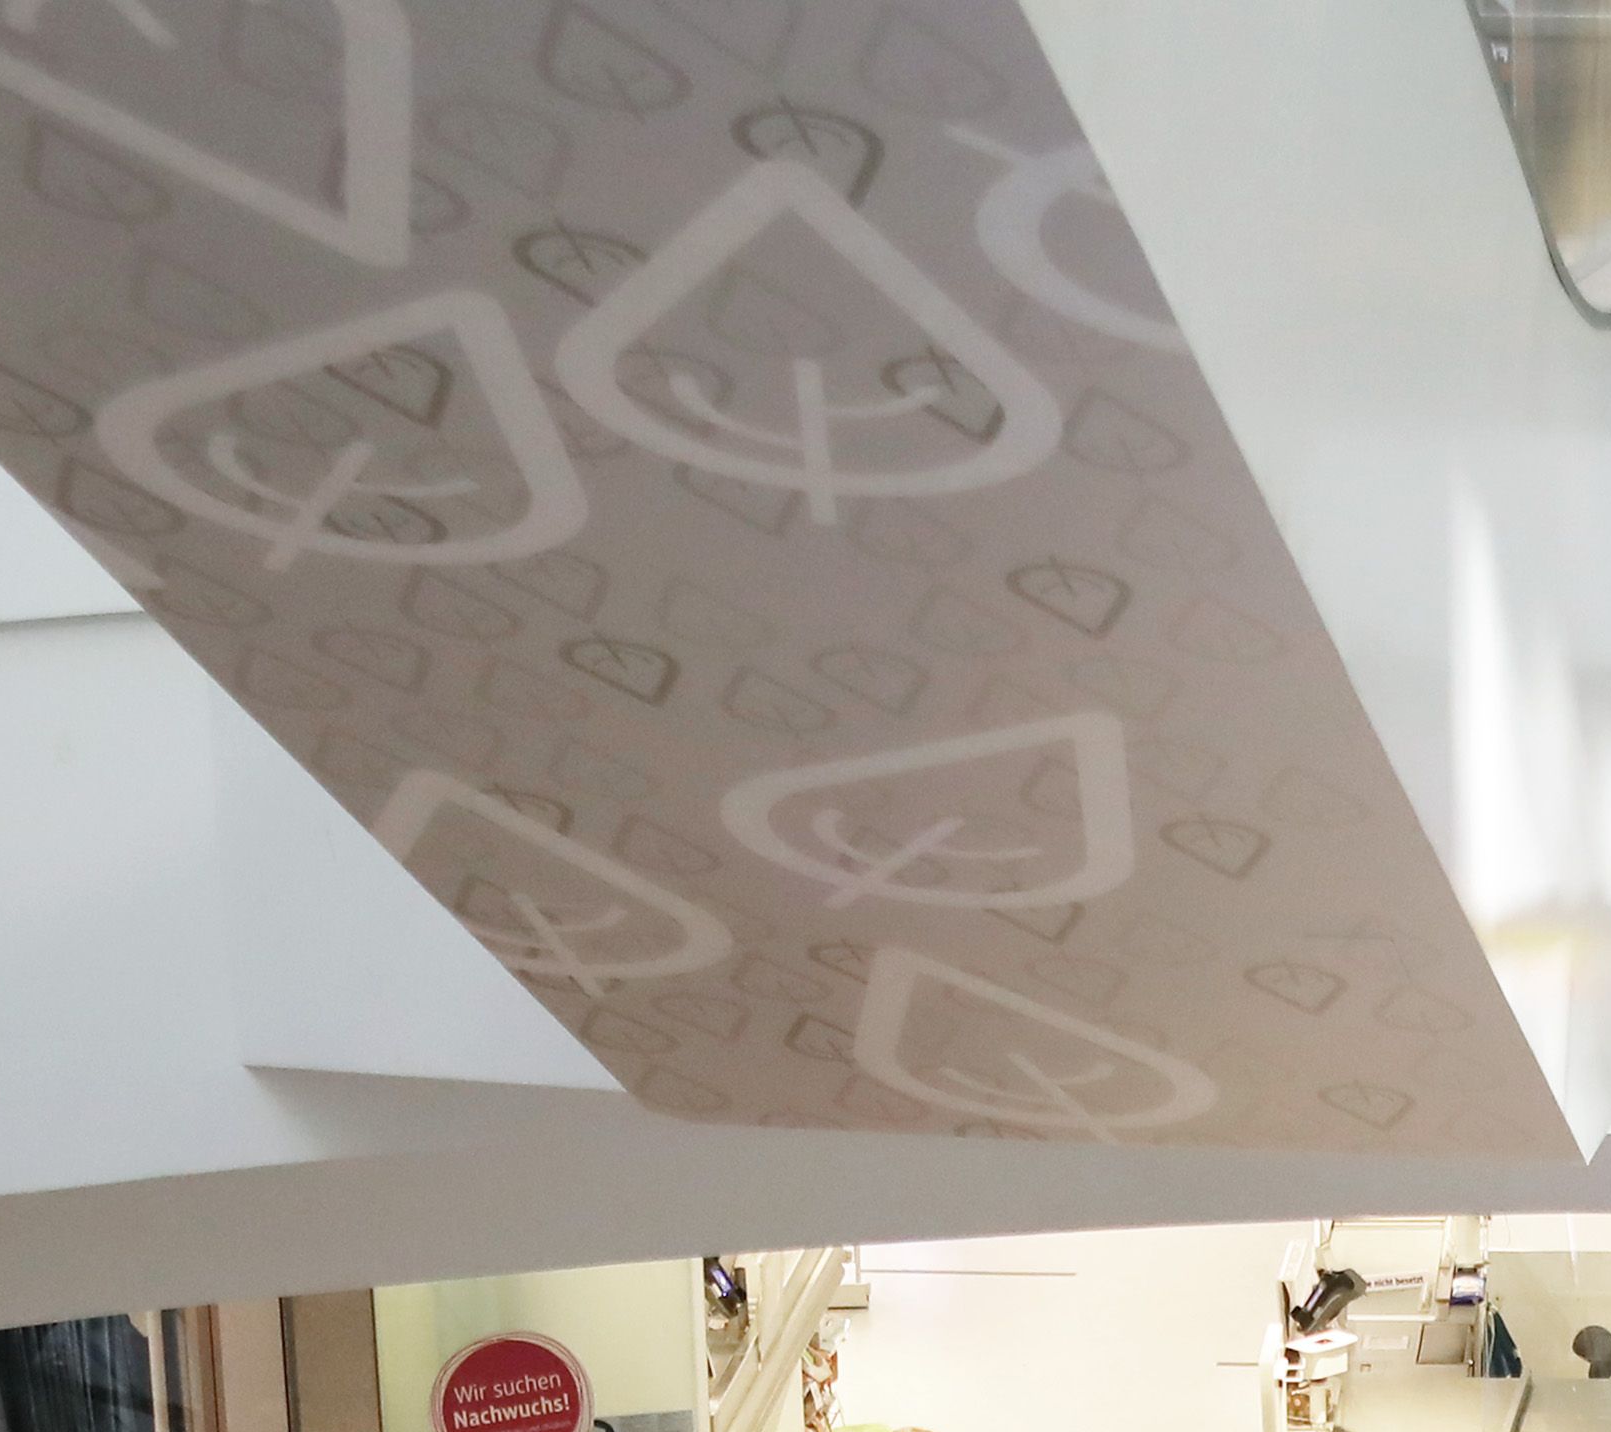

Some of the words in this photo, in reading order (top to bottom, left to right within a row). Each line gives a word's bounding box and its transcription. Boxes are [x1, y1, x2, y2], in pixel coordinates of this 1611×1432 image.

[454, 1384, 486, 1404] Wir
[493, 1373, 561, 1398] suchen
[453, 1393, 570, 1429] Nachwuchs!
